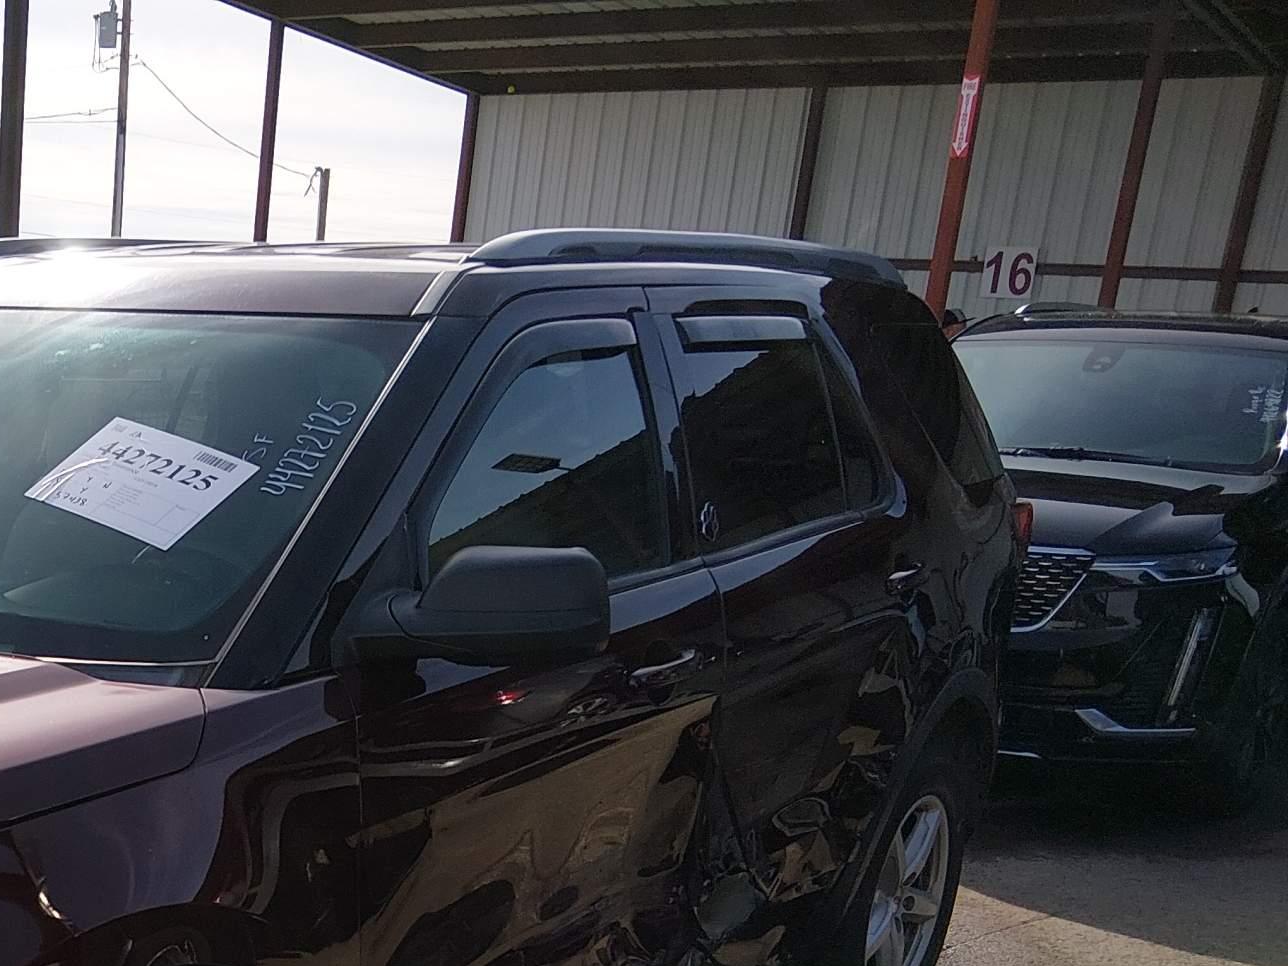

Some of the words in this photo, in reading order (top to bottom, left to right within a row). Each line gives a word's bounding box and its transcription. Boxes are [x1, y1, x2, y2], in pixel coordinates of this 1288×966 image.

[986, 251, 1034, 296] 16
[98, 441, 219, 491] 44272125
[260, 397, 357, 495] 44272125
